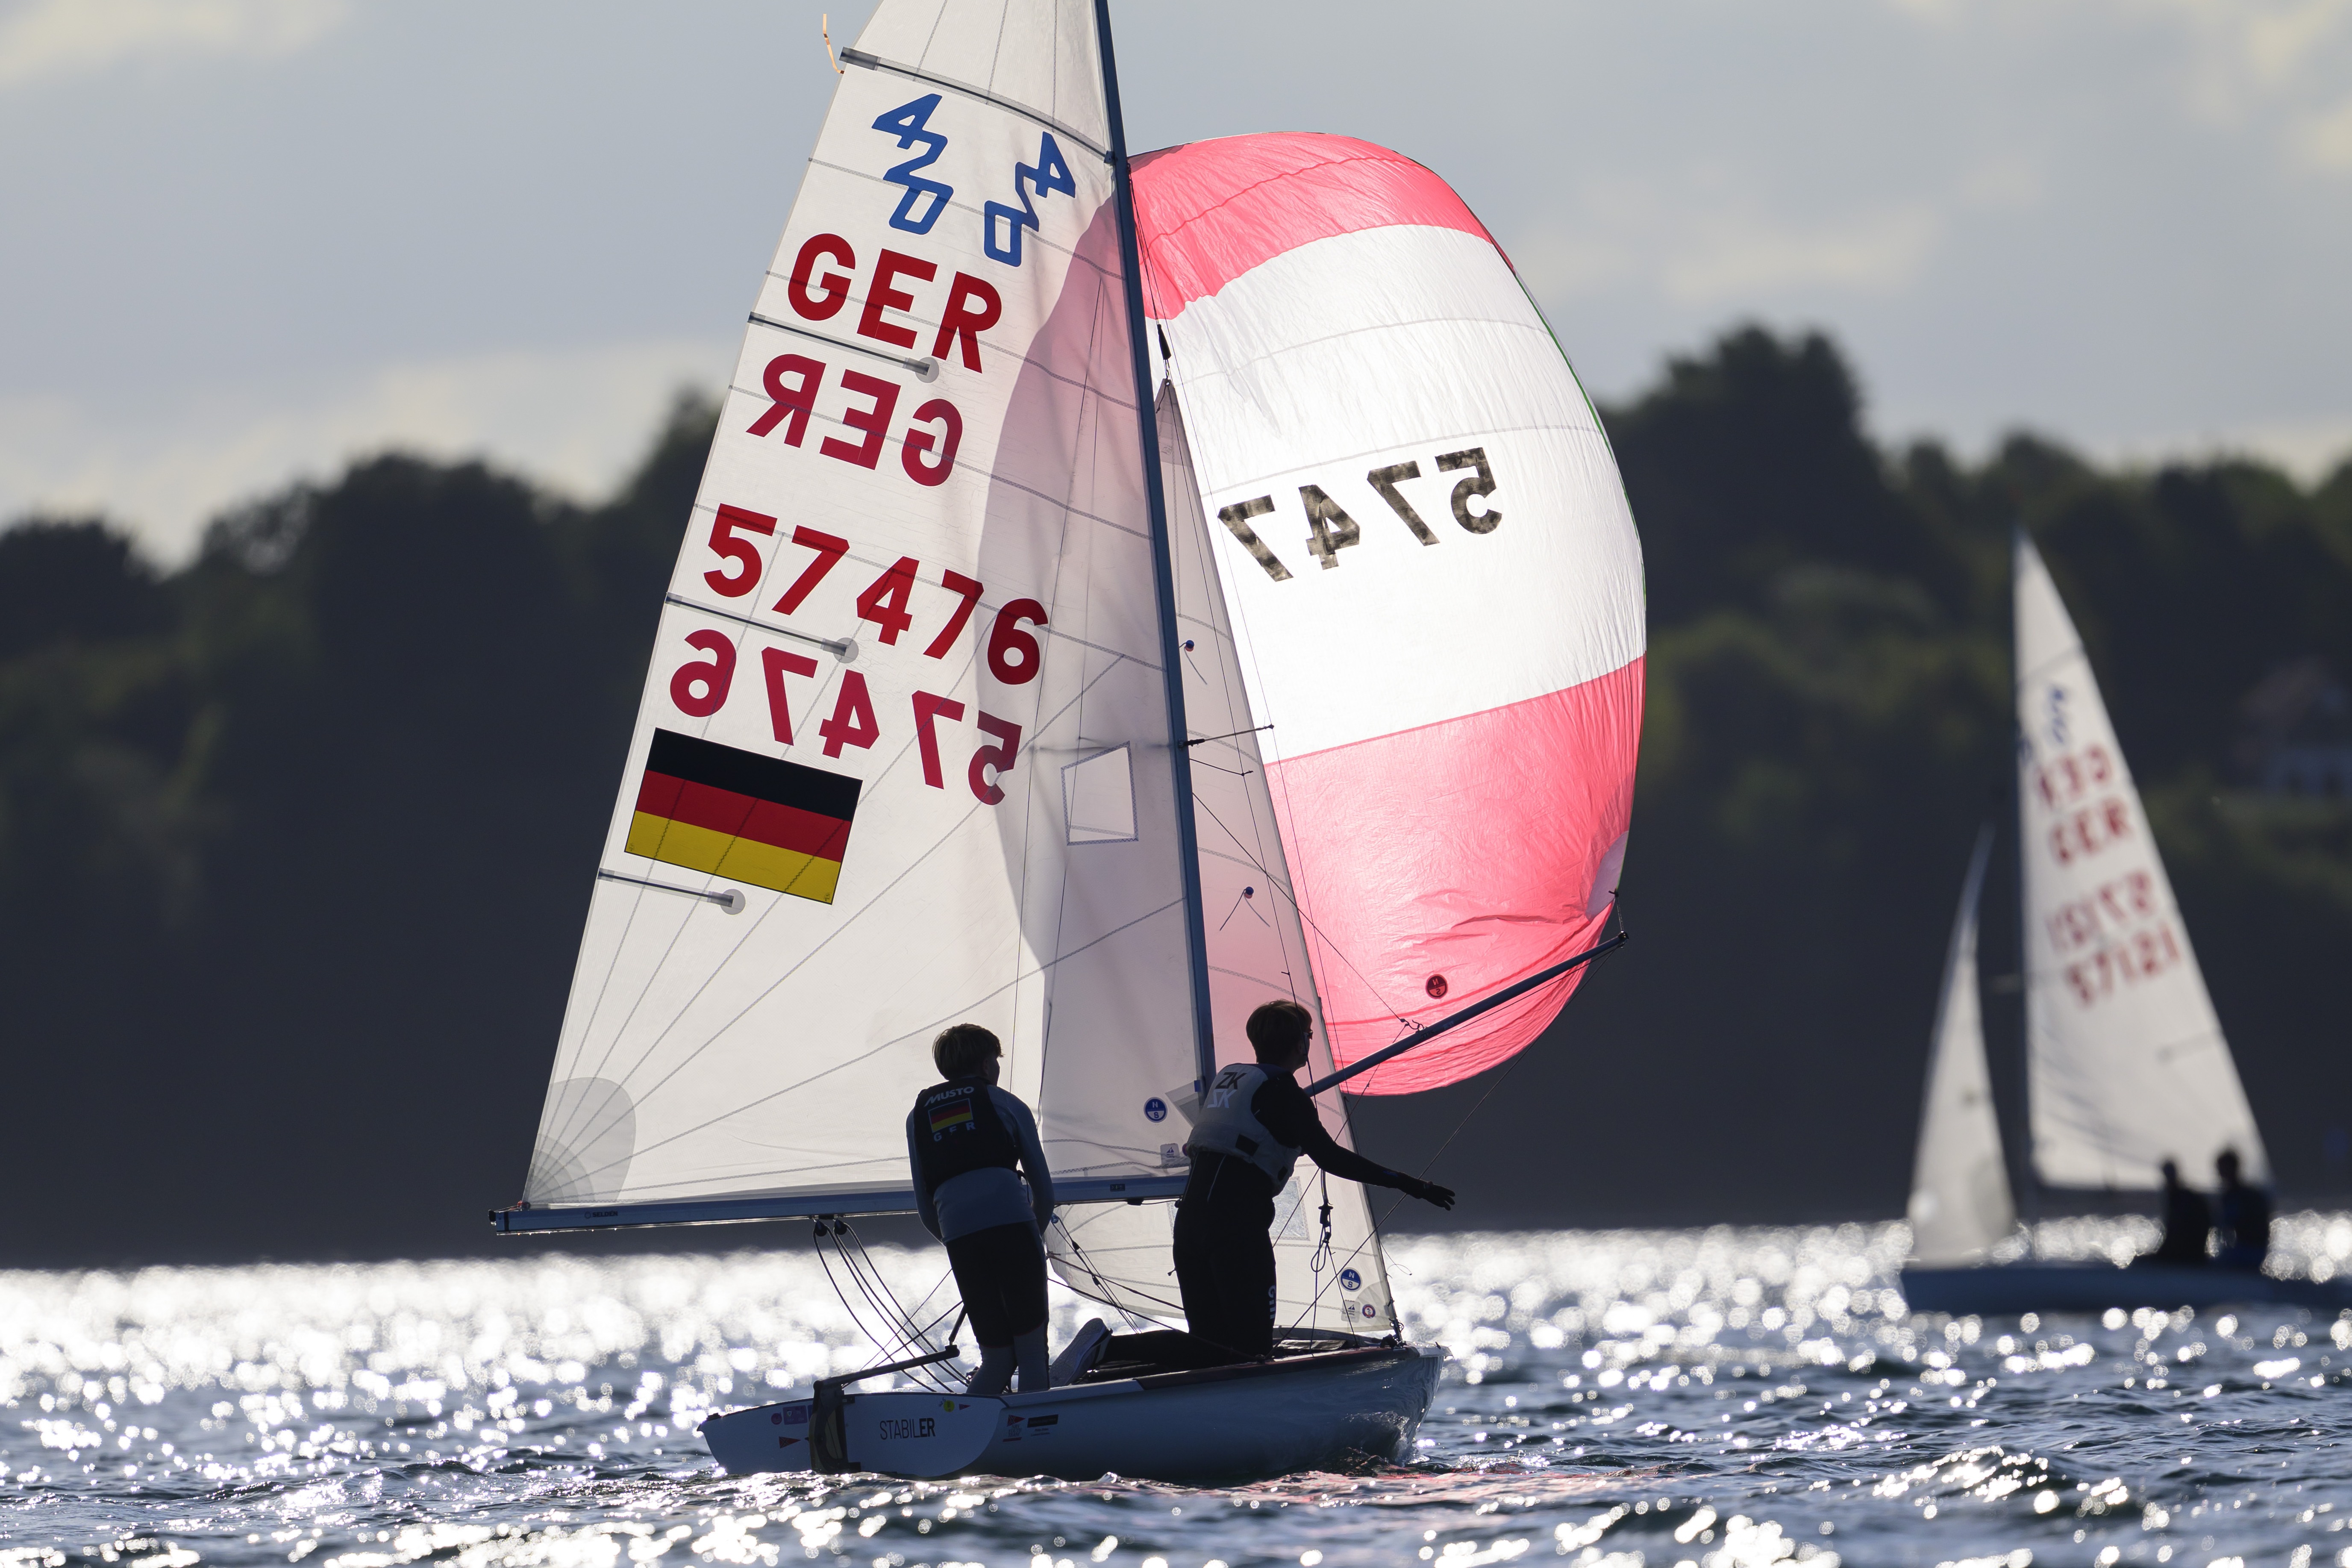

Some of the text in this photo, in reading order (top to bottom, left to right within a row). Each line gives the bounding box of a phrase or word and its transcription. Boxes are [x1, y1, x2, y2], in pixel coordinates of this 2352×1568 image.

[871, 93, 953, 235] 420
[788, 233, 1002, 374] GER
[703, 503, 1048, 685] 57476
[923, 1086, 974, 1107] MUSTO
[1215, 1071, 1247, 1089] ZK
[879, 1418, 936, 1440] STABILER
